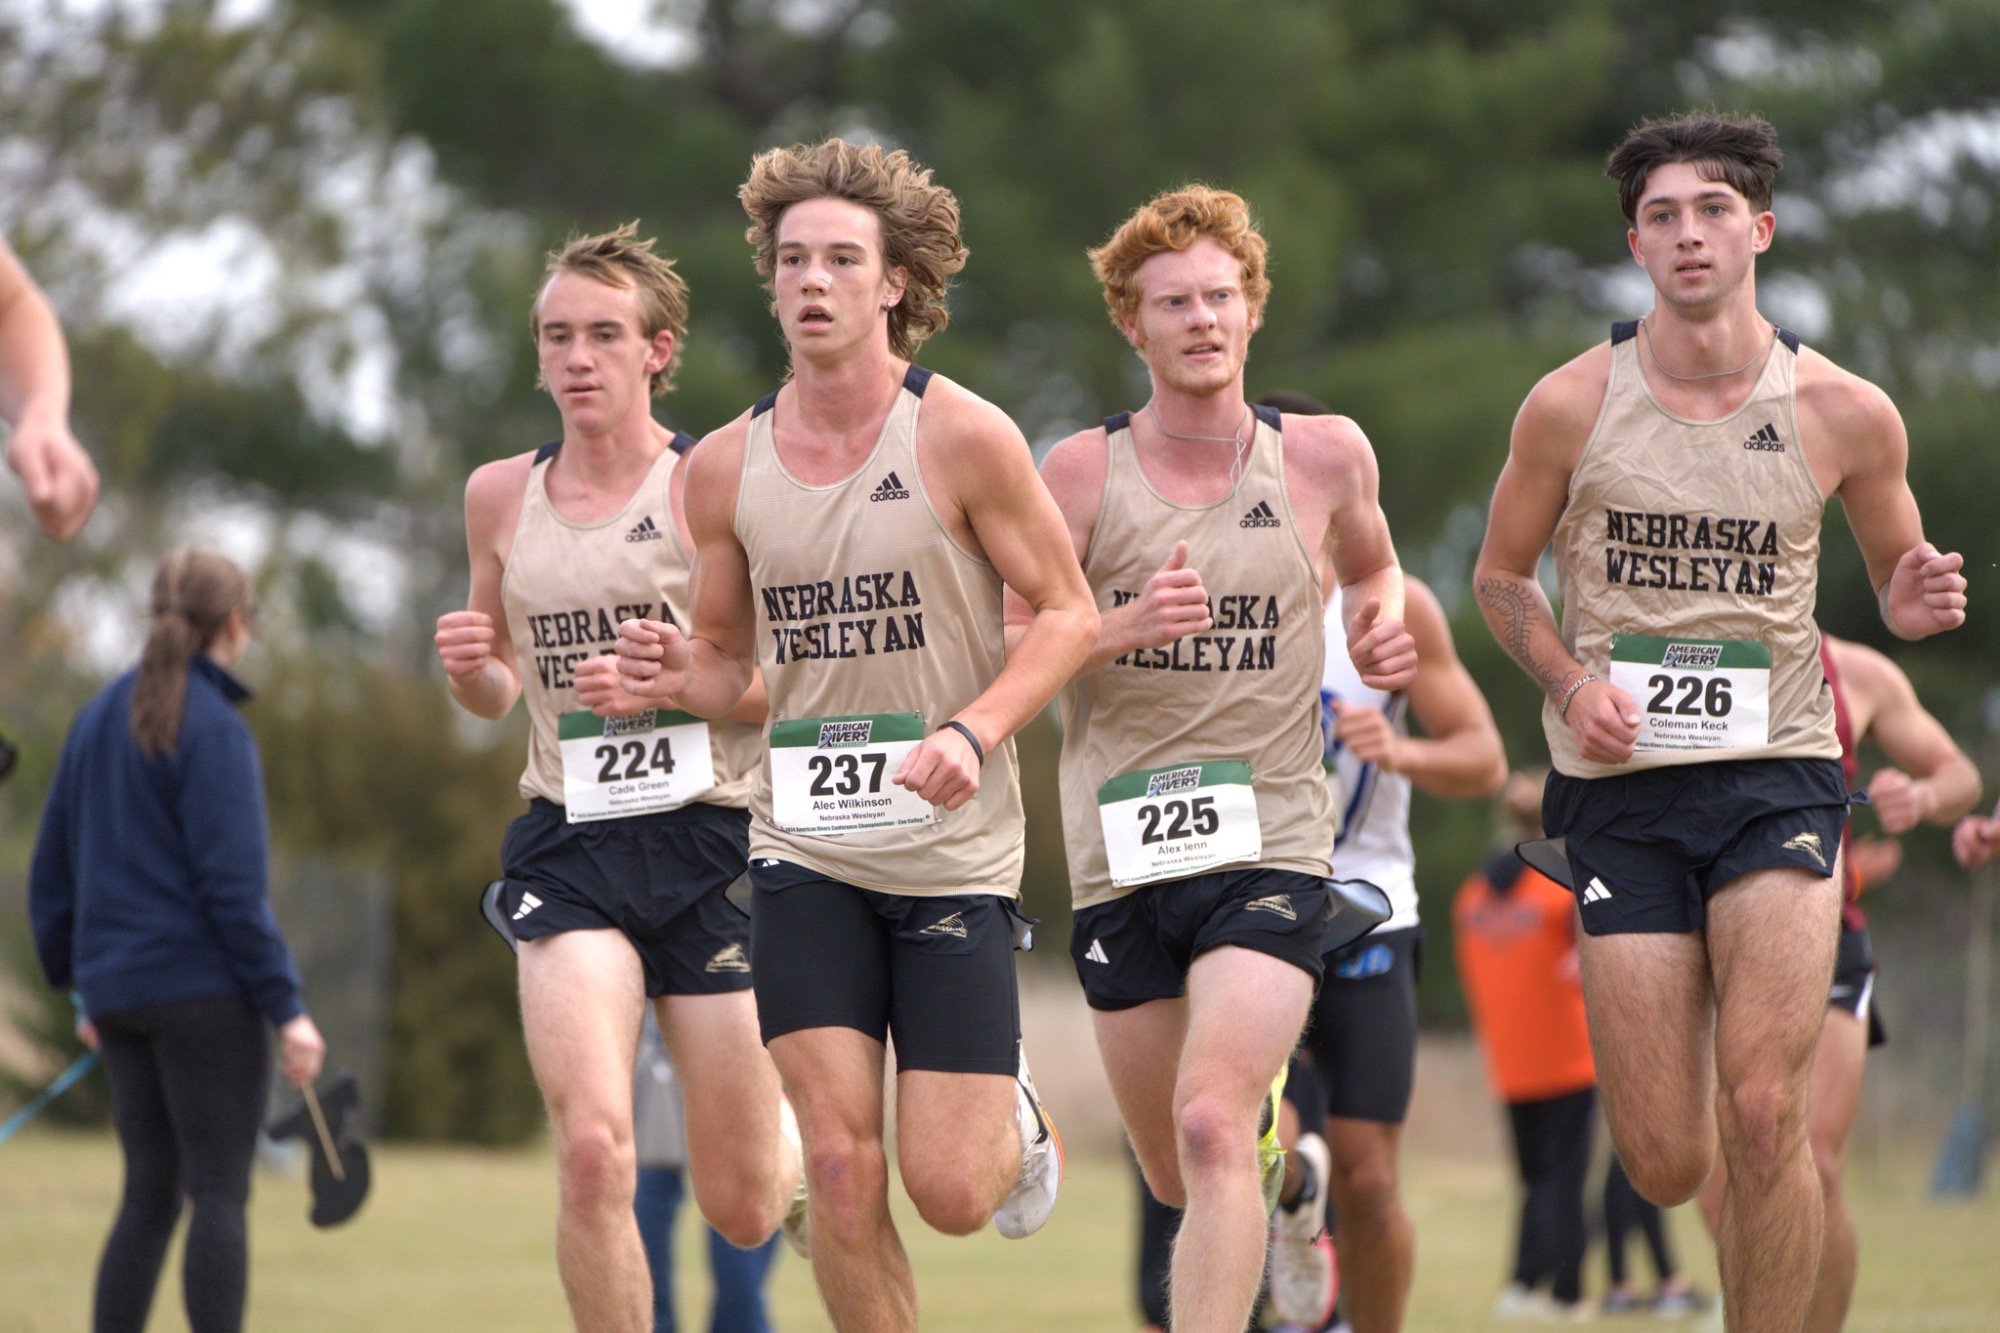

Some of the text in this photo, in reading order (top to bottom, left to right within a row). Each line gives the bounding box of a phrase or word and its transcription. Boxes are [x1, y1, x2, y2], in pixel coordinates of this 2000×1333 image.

[1743, 439, 1785, 453] adidas
[870, 488, 910, 502] adidas
[1240, 517, 1281, 529] adidas
[625, 529, 662, 543] adidas
[1605, 508, 1779, 556] NEBRASKA
[1605, 547, 1776, 596] WESLEYAN
[761, 570, 921, 622] NEBRASKA
[772, 612, 926, 665] WESLEYAN
[1668, 644, 1720, 655] AMERICAN
[1662, 652, 1718, 668] RIVERS
[1646, 674, 1732, 718] 226
[821, 722, 871, 733] AMERICAN
[1649, 717, 1729, 731] Coleman Keck
[818, 730, 868, 749] RIVERS
[1653, 732, 1722, 742] Nebraska Wesleyan
[595, 736, 676, 783] 224
[808, 752, 887, 797] 237
[1151, 768, 1200, 783] AMERICAN
[608, 779, 670, 796] Cade Green
[1147, 776, 1198, 798] RIVERS
[812, 797, 893, 811] Alec Wilkinson
[819, 811, 886, 822] Nebraska Wesleyan
[1137, 796, 1220, 846] 225
[858, 820, 895, 830] Championships
[1157, 845, 1182, 856] Alex
[1151, 857, 1183, 868] Nebraska
[1183, 853, 1217, 863] Wesleyan
